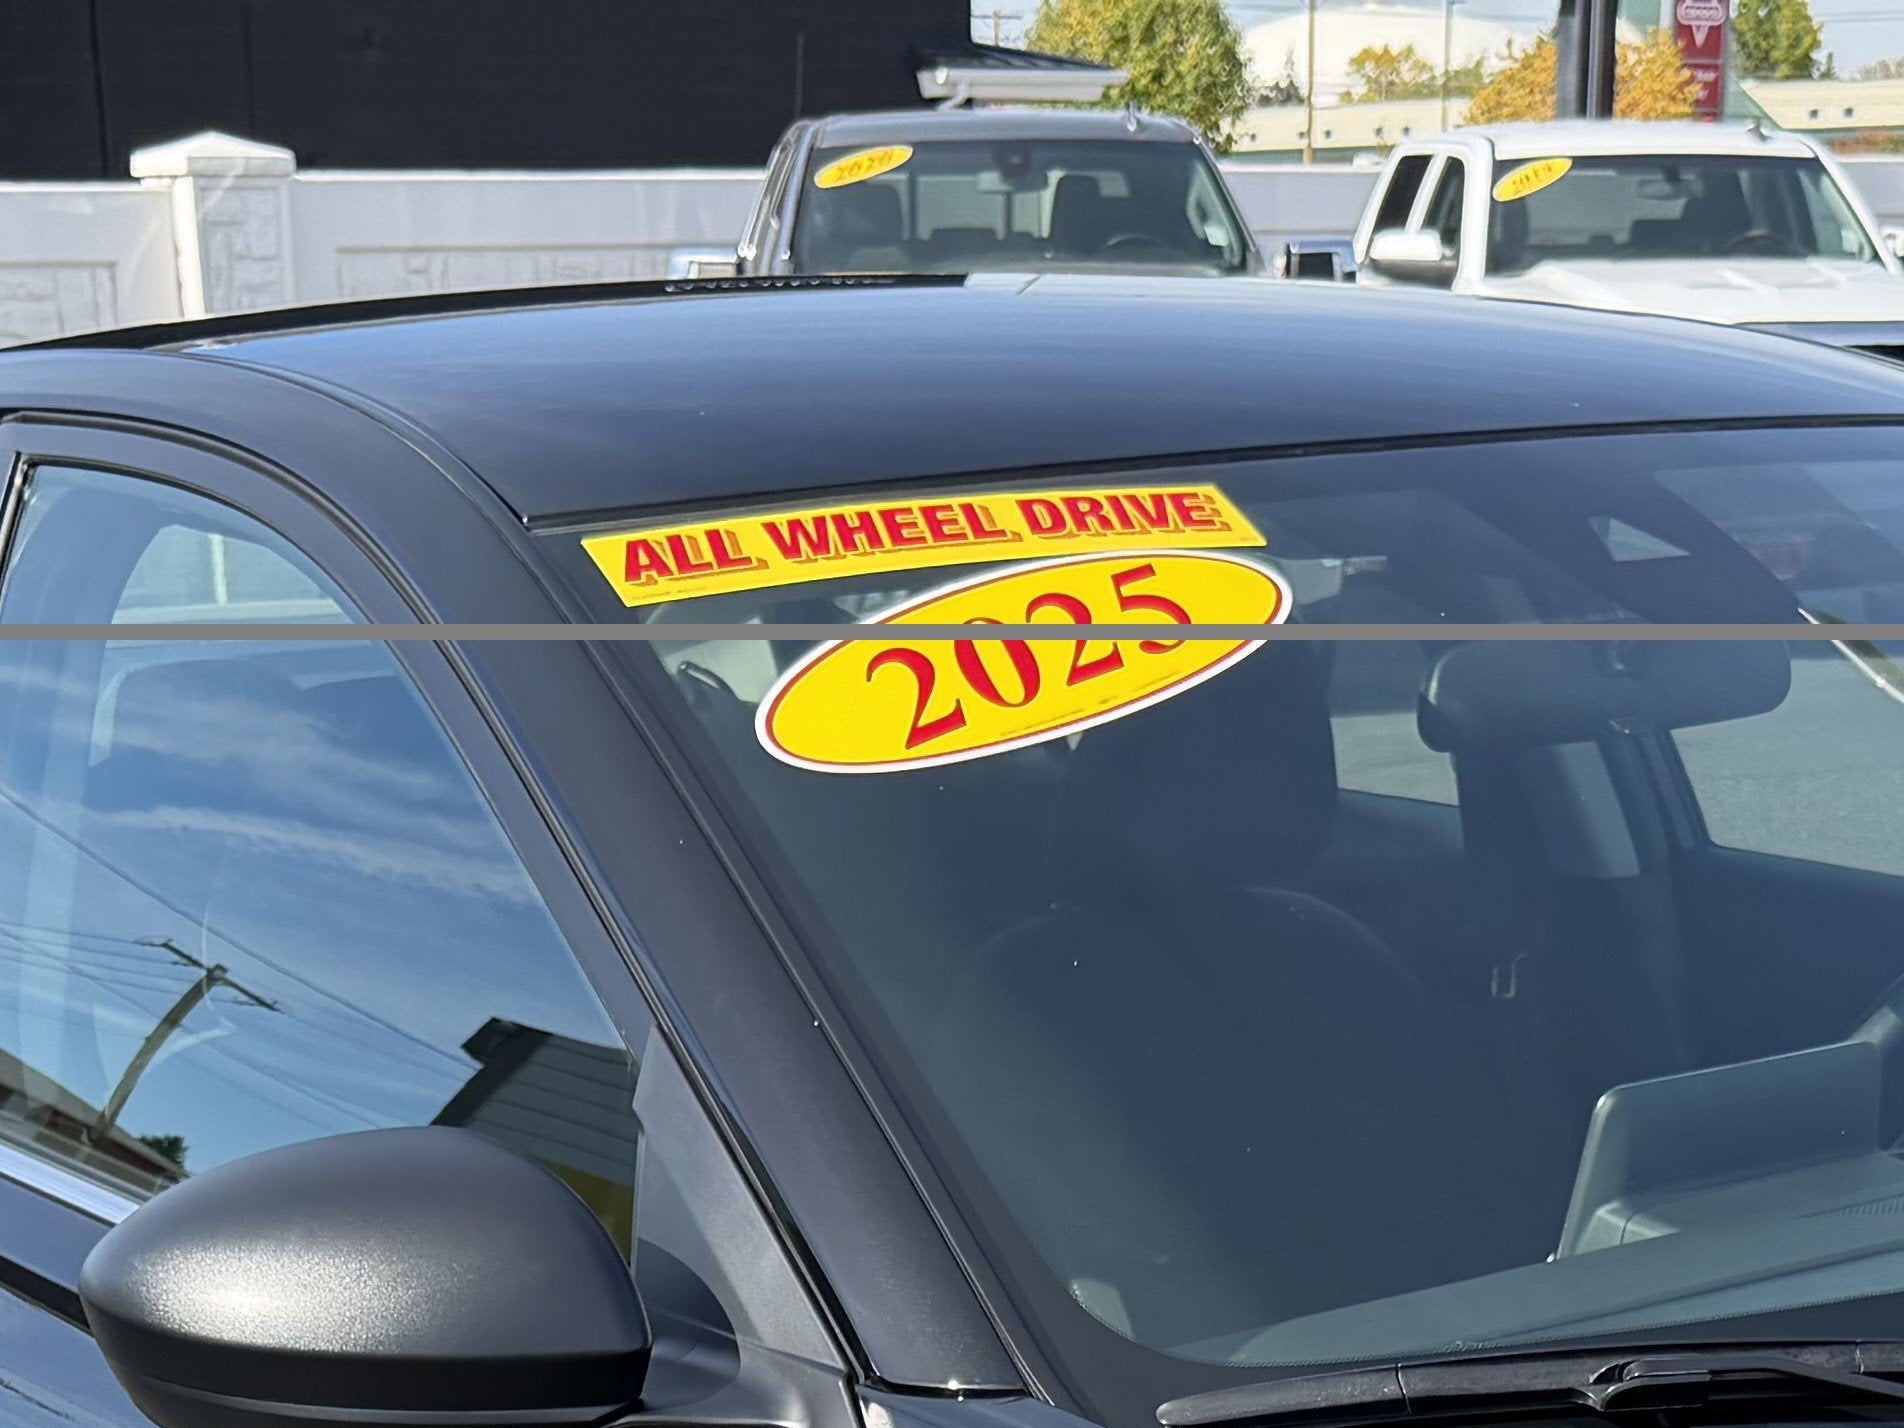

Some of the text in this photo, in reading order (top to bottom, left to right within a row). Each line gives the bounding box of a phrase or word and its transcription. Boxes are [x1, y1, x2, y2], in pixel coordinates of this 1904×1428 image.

[623, 492, 1226, 585] ALL WHEEL DRIVE
[866, 563, 1194, 751] 2025
